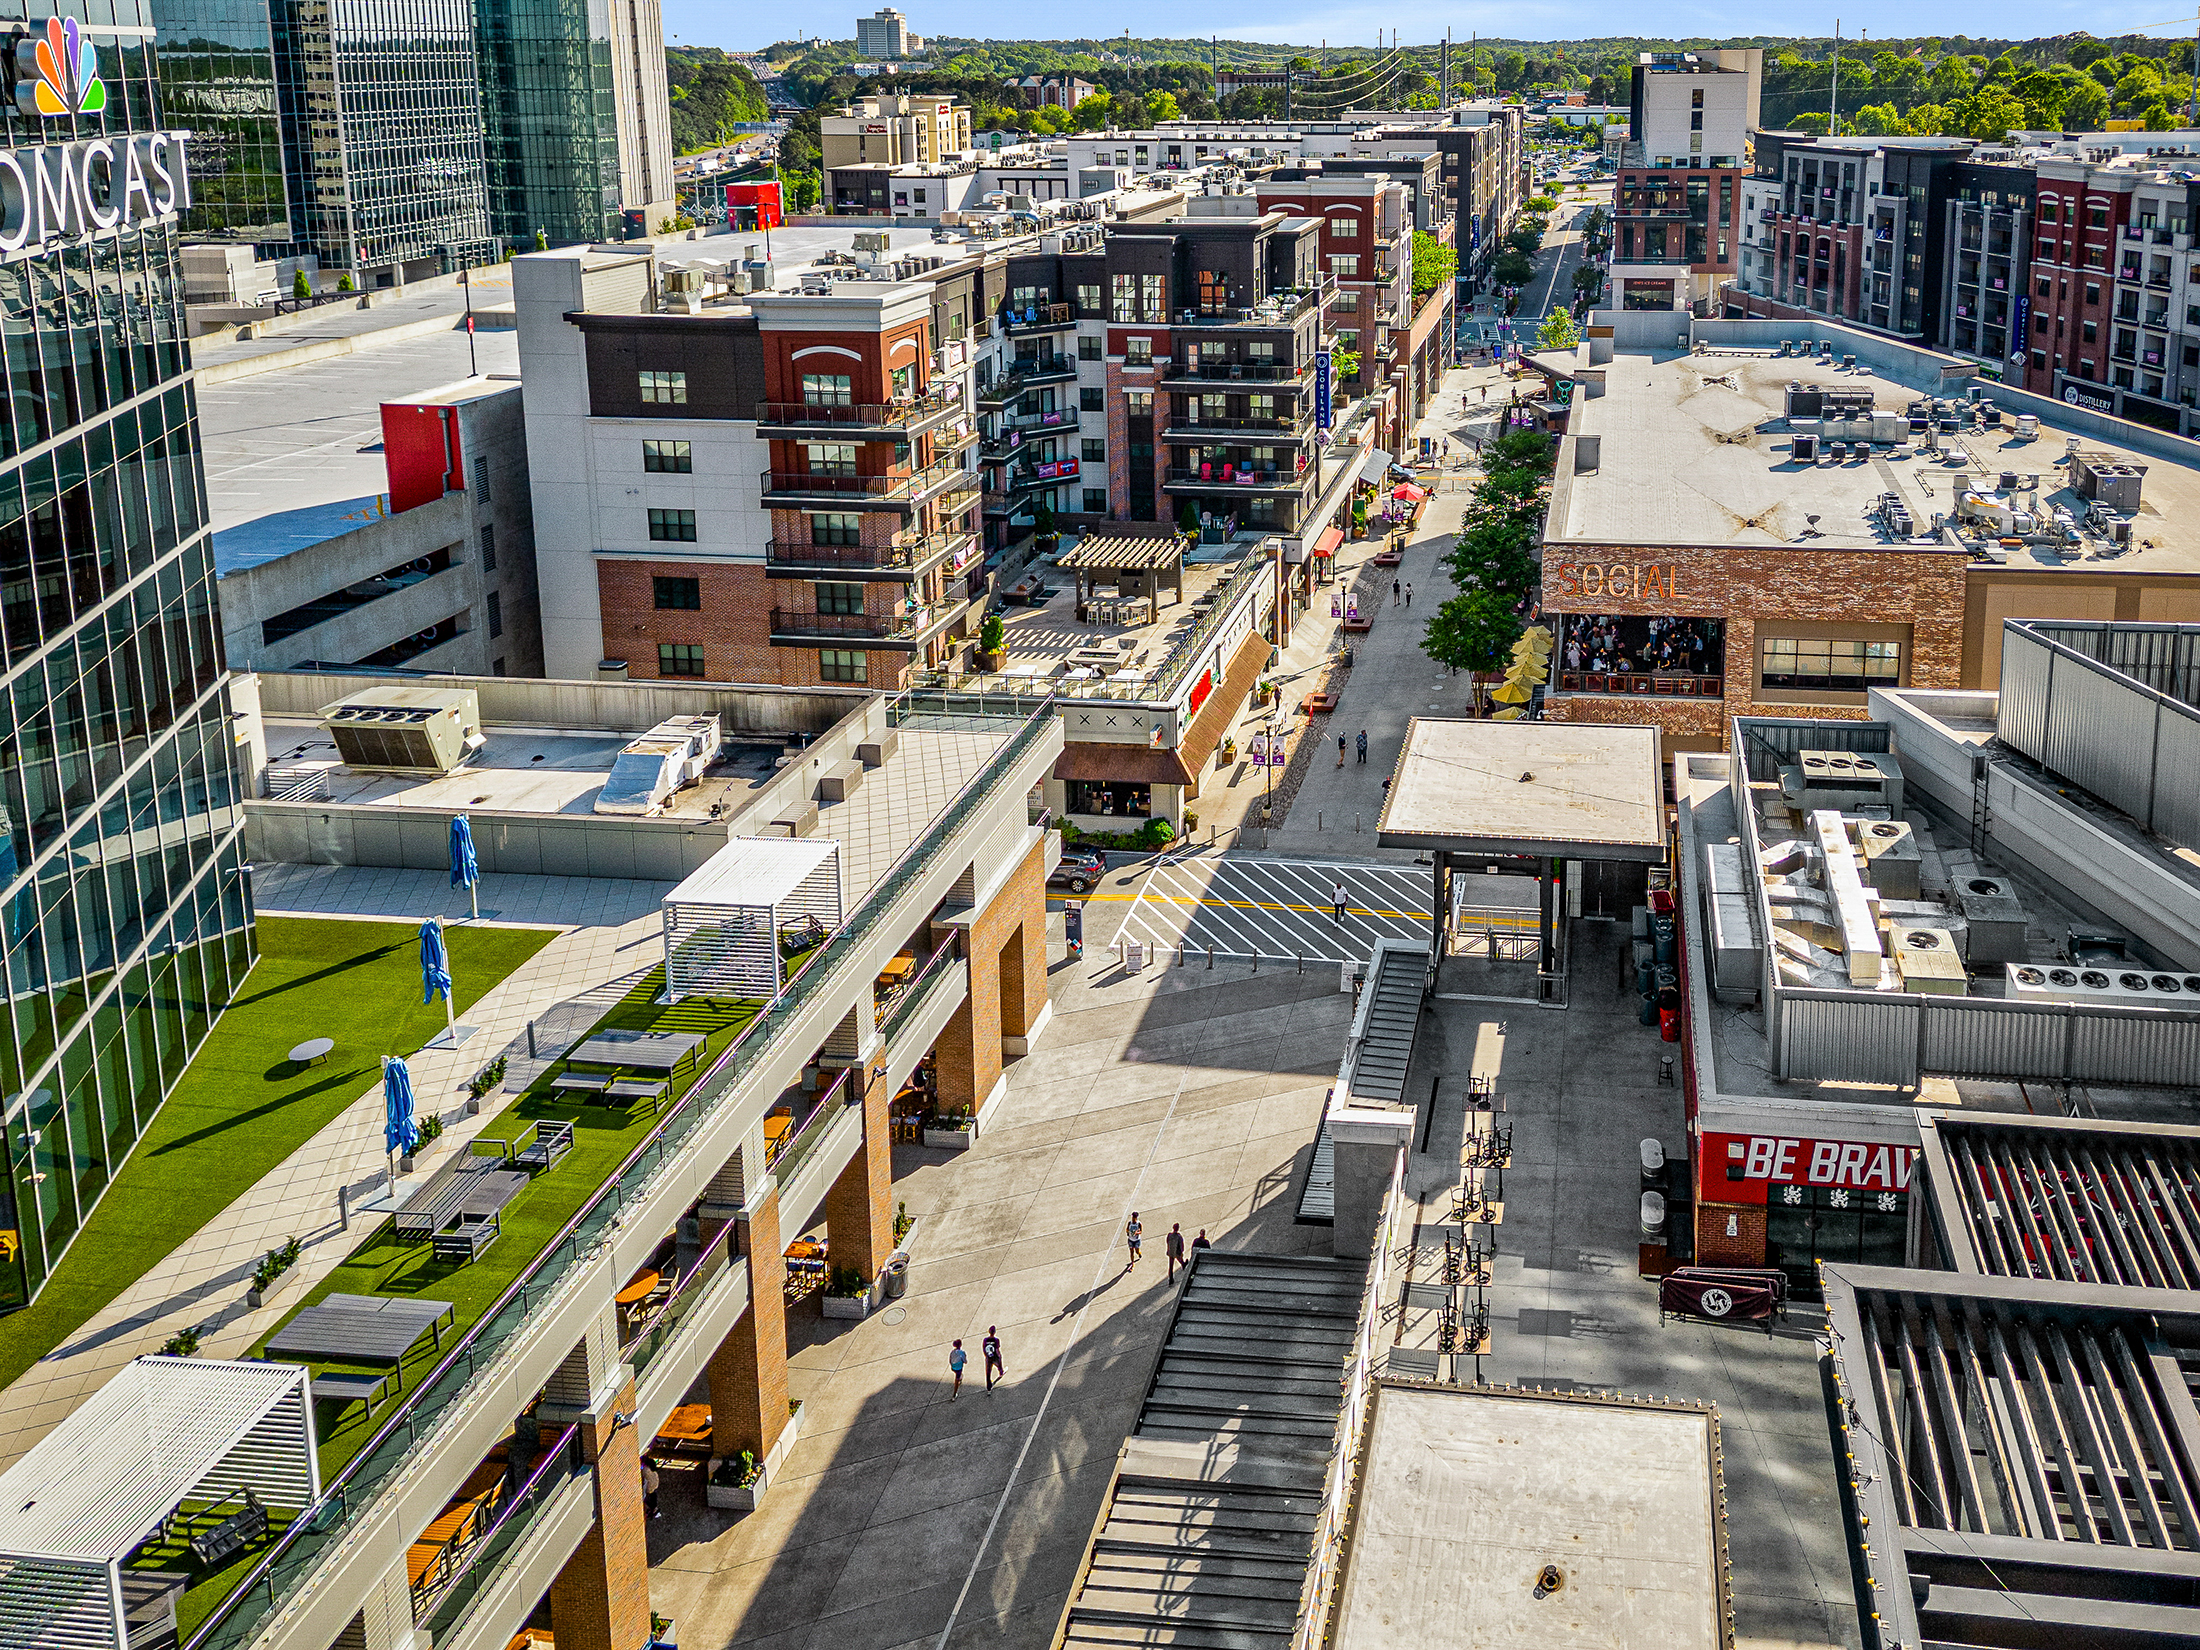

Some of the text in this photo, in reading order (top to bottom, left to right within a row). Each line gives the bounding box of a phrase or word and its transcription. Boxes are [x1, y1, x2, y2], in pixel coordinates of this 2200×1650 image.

[2078, 393, 2112, 410] DISTILLERY
[1559, 563, 1689, 599] SOCIAL
[1744, 1137, 1800, 1181] BE
